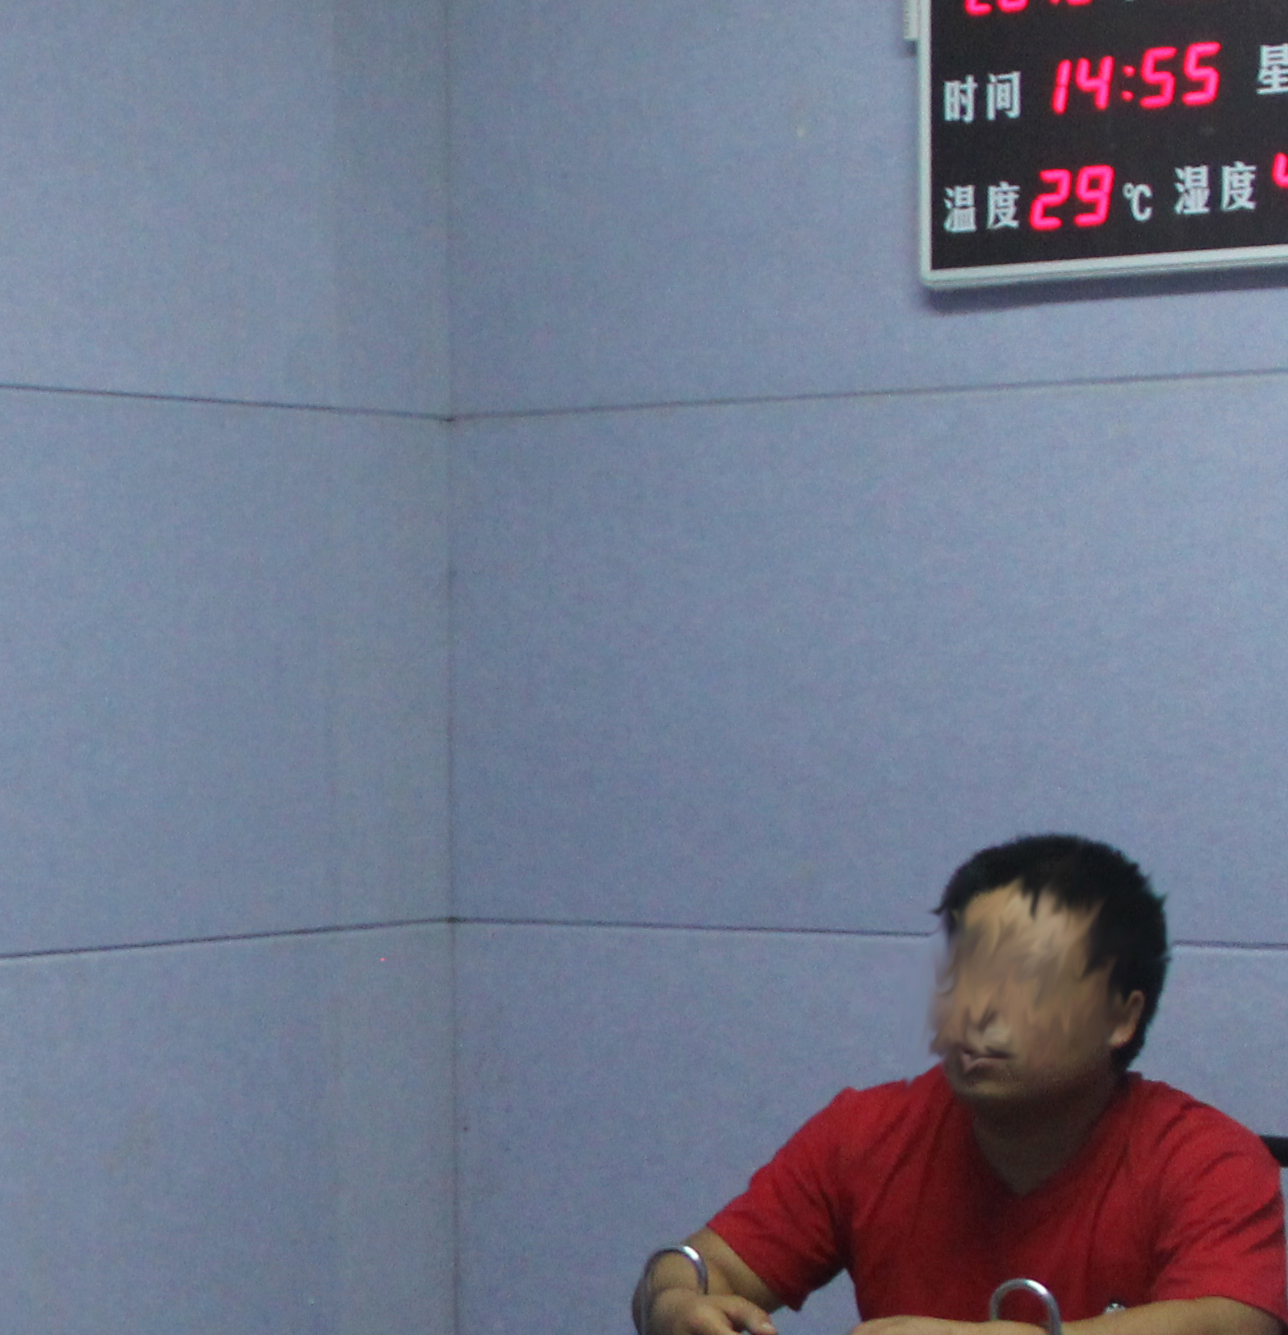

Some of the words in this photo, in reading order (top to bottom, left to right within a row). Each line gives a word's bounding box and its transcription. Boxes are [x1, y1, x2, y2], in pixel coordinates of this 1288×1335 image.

[943, 71, 1022, 124] 时间
[1051, 41, 1222, 115] 14:55
[943, 181, 1021, 233] 温度
[1028, 164, 1115, 231] 29
[1174, 160, 1258, 216] 湿度
